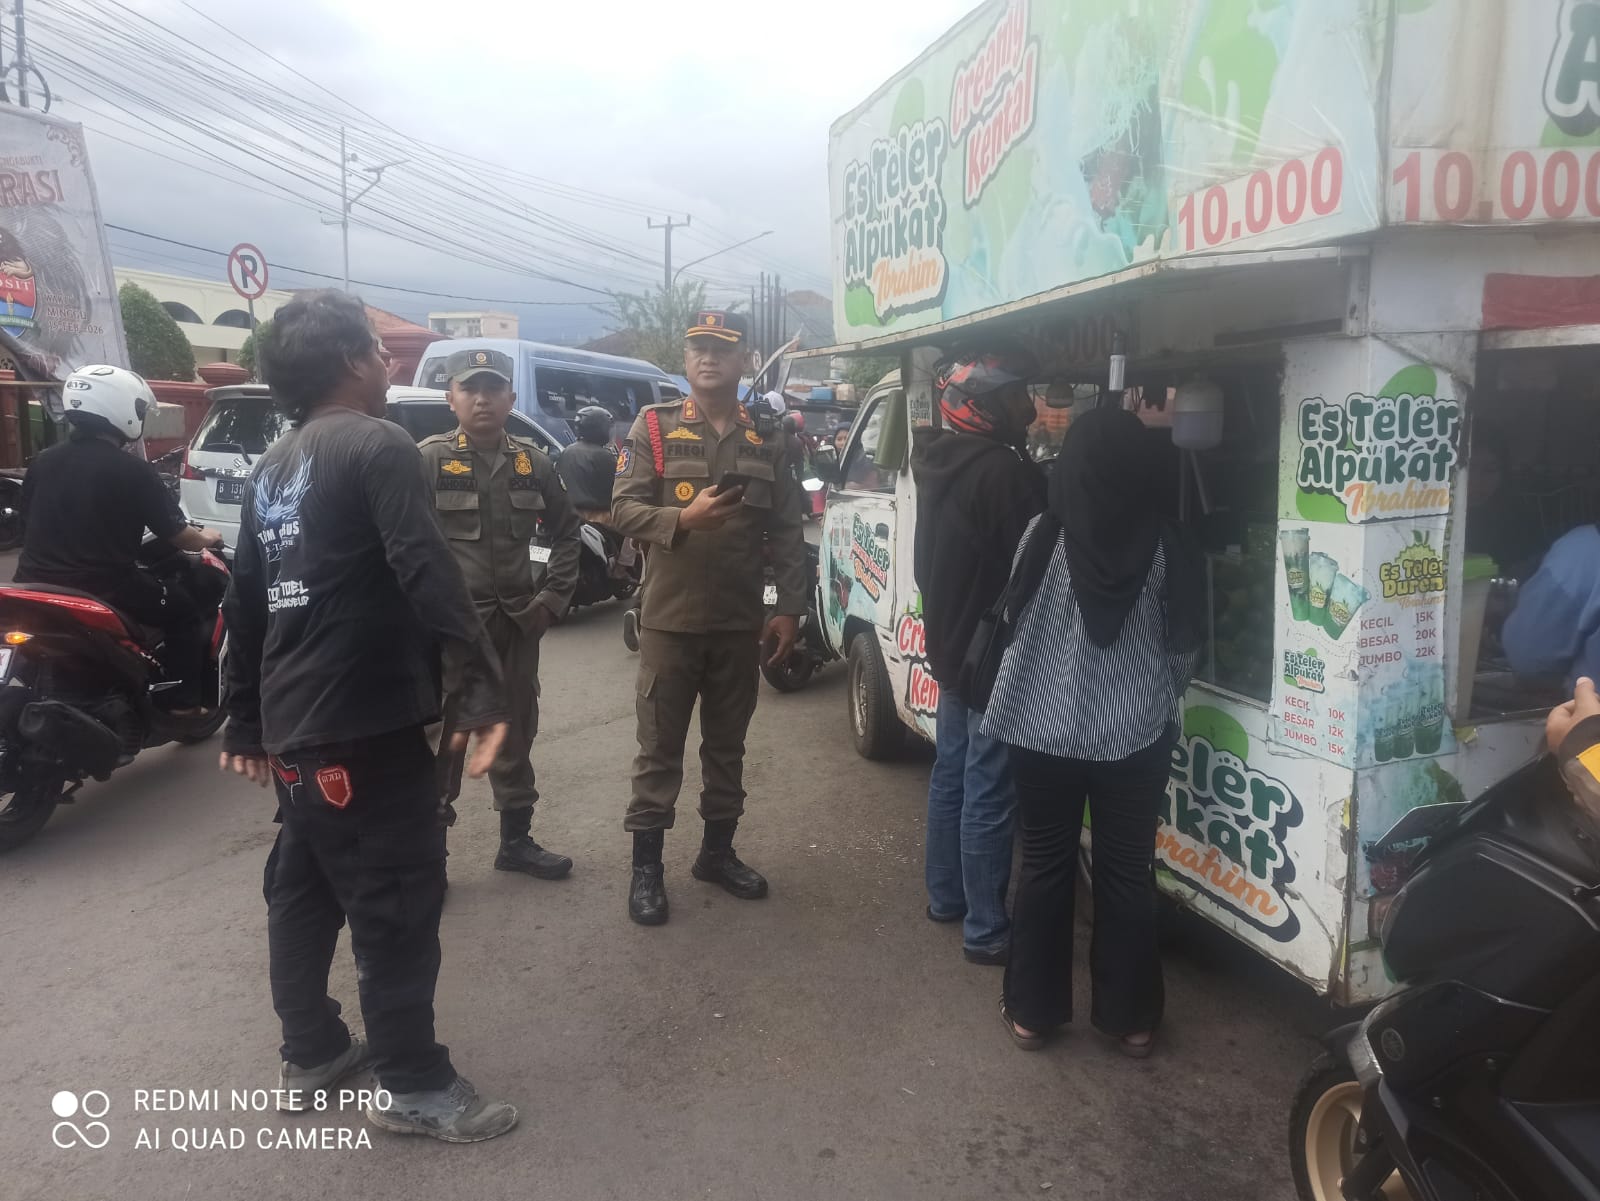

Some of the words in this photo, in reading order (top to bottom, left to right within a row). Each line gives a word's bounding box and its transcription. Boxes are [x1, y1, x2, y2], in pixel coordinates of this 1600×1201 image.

[951, 3, 1025, 138] Creamy
[967, 50, 1034, 199] Kental
[844, 166, 869, 221] Es
[871, 124, 943, 206] Teler
[1178, 146, 1344, 252] 10.000
[844, 186, 942, 281] Alpukat
[872, 250, 941, 307] Ibrahim
[1300, 401, 1341, 442] Es
[1349, 397, 1458, 443] Teler
[1299, 443, 1453, 492] Alpukat
[1344, 478, 1452, 517] Ibrahim
[1359, 616, 1395, 631] KECIL
[1415, 610, 1435, 624] 15K
[1359, 633, 1399, 648] BESAR
[1415, 627, 1437, 641] 20K
[1284, 662, 1322, 683] Alpukat
[1358, 650, 1403, 666] JUMBO
[1415, 645, 1436, 658] 22K
[1284, 695, 1311, 712] KECIL
[1328, 707, 1345, 721] 10K
[1284, 711, 1315, 728] BESAR
[1328, 724, 1344, 738] 12K
[1284, 727, 1317, 746] JUMBO
[1327, 741, 1345, 756] 15K
[1170, 741, 1287, 822] eler
[1160, 786, 1279, 881] kat
